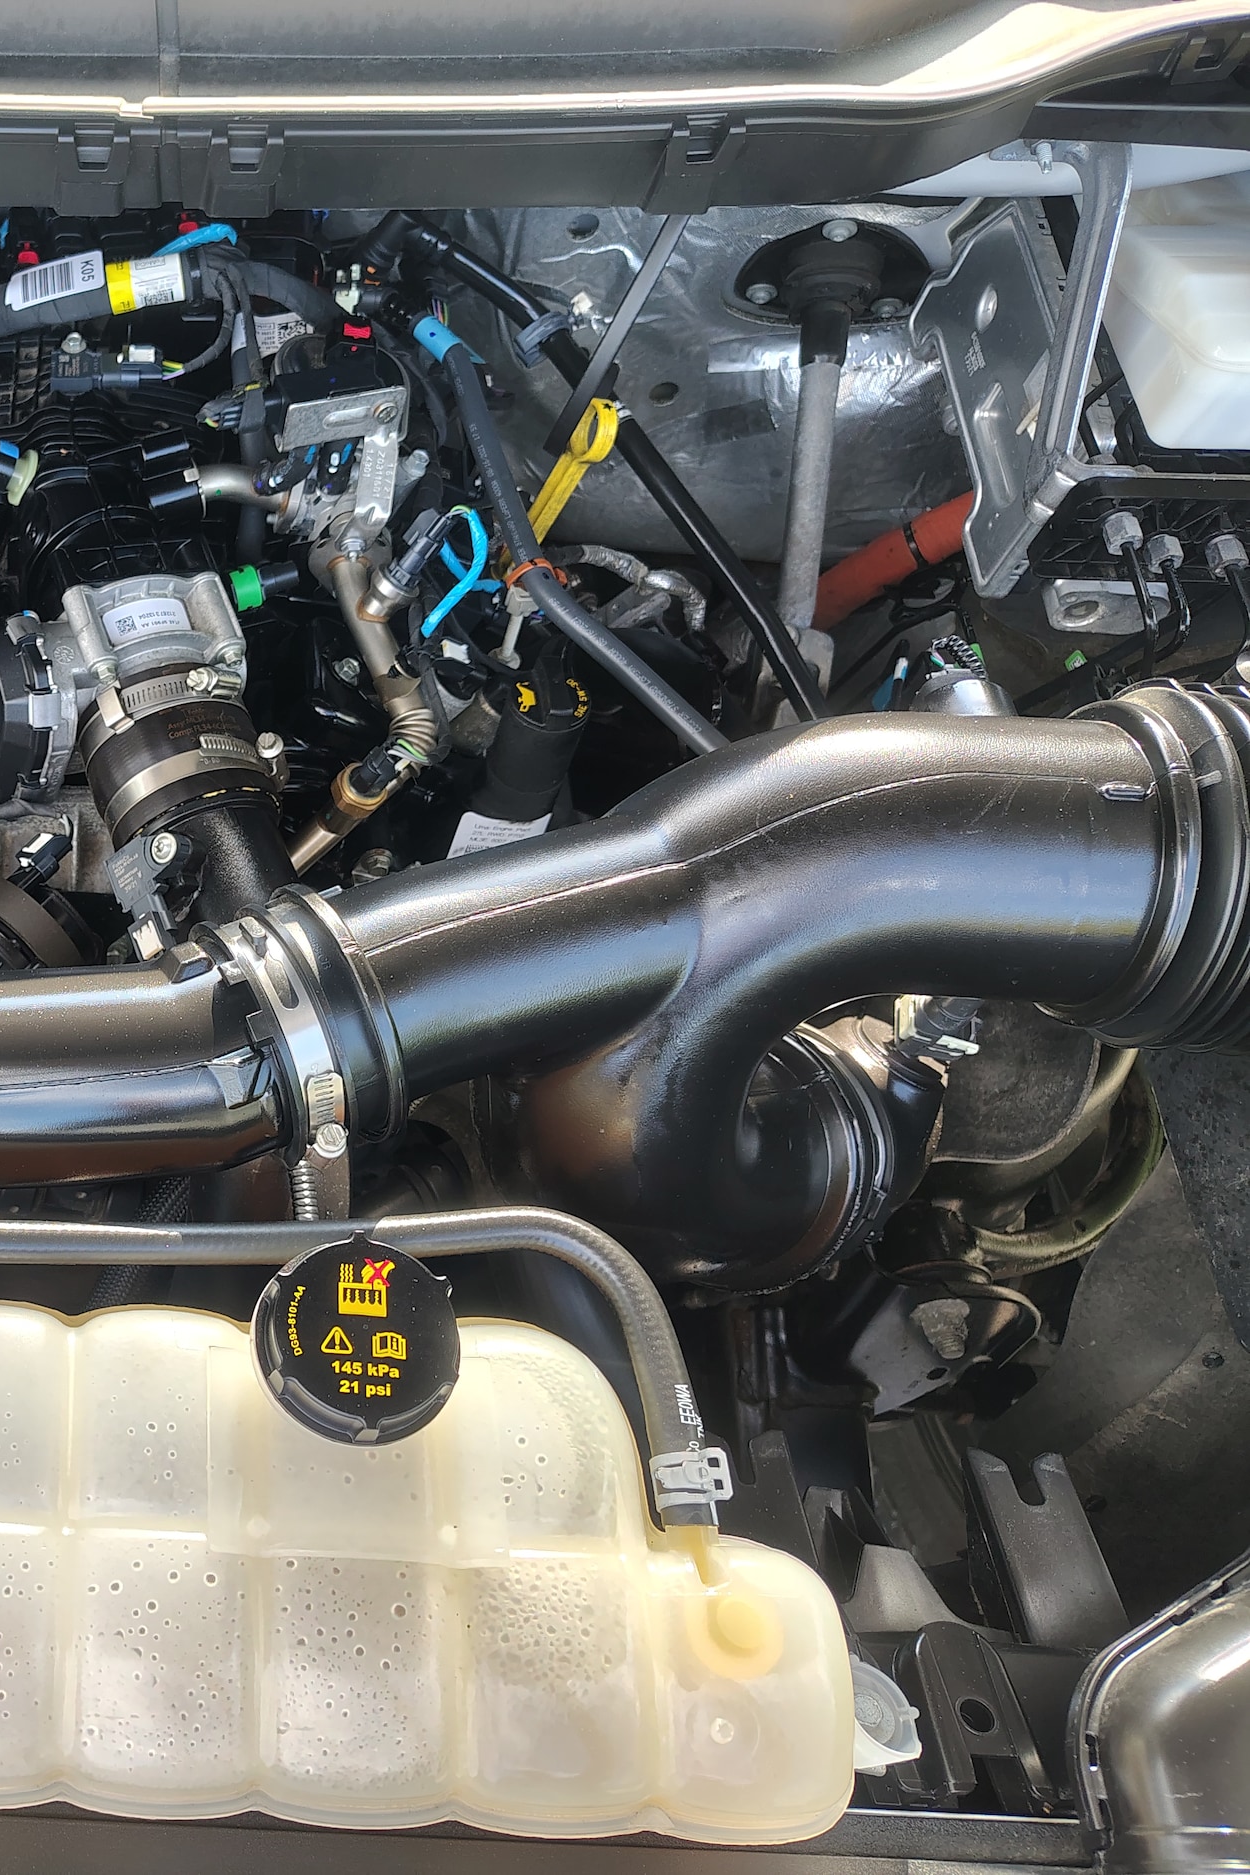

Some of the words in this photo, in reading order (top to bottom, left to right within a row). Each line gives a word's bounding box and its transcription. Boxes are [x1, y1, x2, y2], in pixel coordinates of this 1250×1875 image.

[80, 259, 94, 282] K05
[565, 677, 587, 701] 5W-30
[573, 704, 586, 718] SAE
[288, 1284, 306, 1356] DG93-8101-AA
[331, 1361, 362, 1376] 145
[366, 1362, 400, 1378] kPa
[339, 1380, 360, 1396] 21
[365, 1381, 391, 1398] psi
